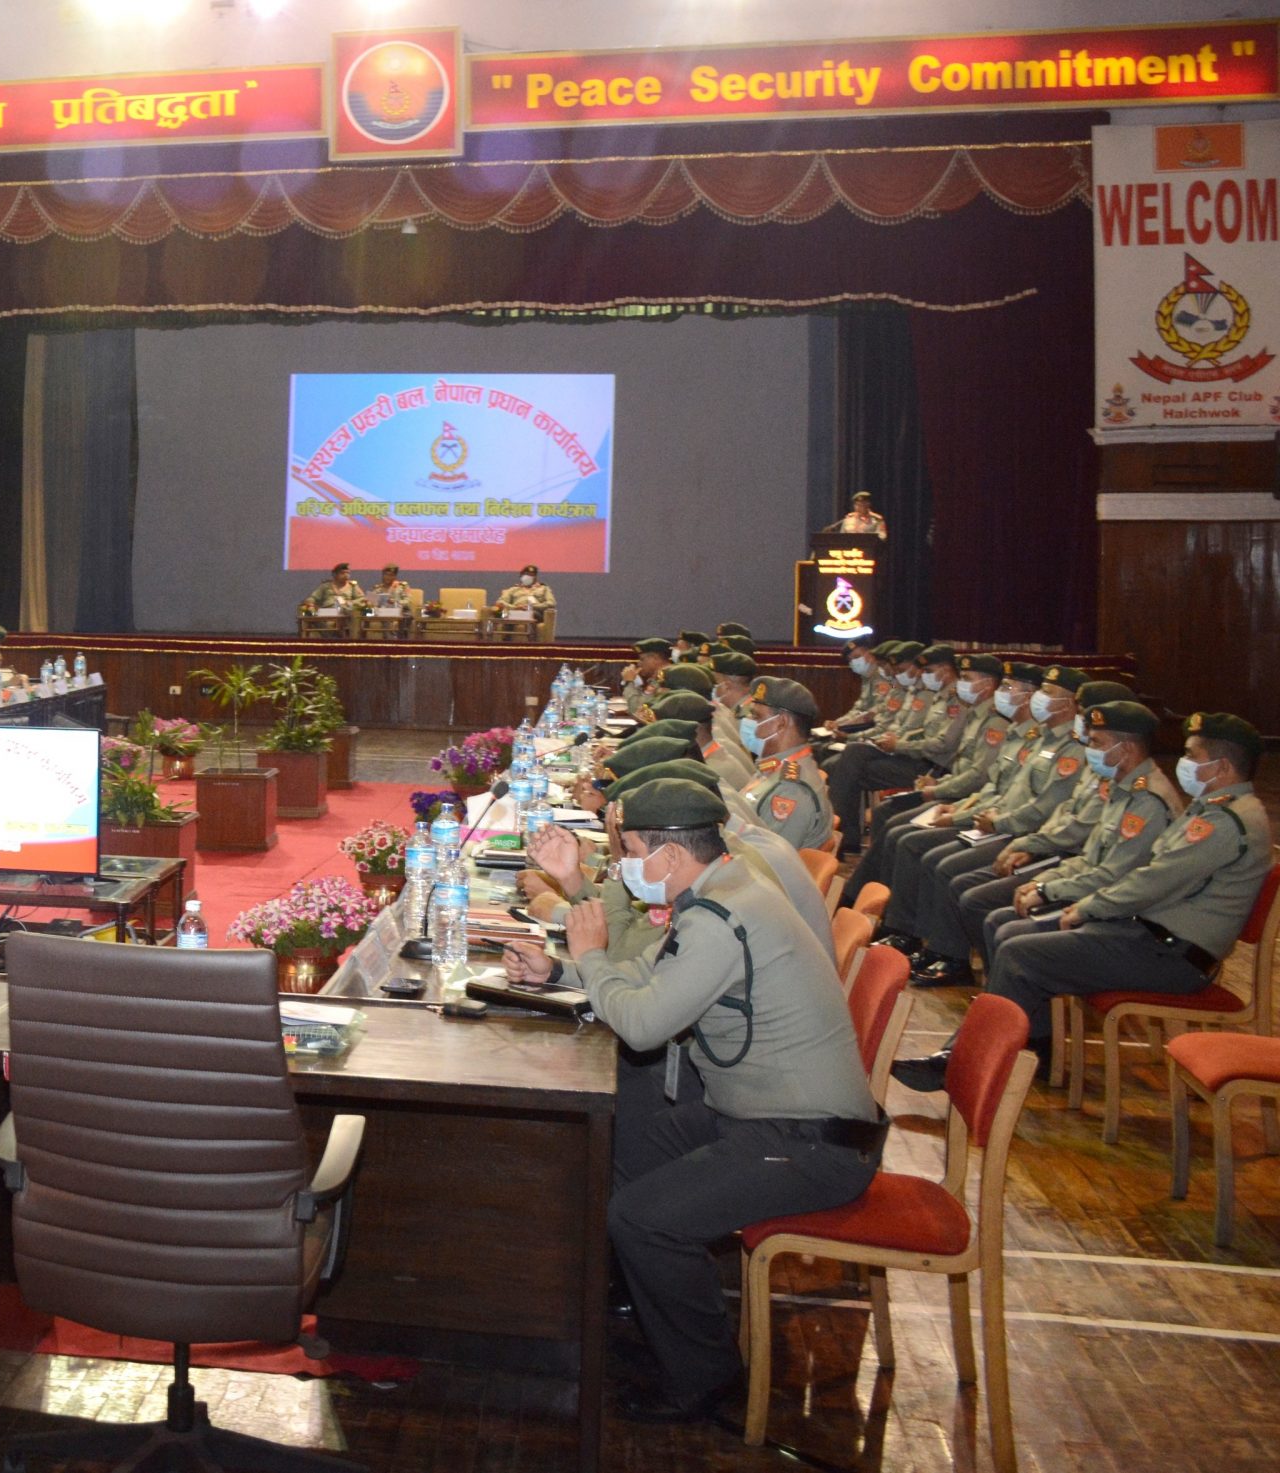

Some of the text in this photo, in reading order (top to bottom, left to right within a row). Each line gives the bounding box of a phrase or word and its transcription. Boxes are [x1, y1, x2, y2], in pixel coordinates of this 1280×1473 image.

[526, 73, 662, 109] Peace
[690, 59, 882, 105] Security
[908, 50, 1219, 93] Commitment
[1141, 391, 1264, 405] Nepal APF Club
[305, 424, 353, 480] सशस्त्र
[350, 392, 396, 434] प्रहरी
[433, 379, 484, 405] नेपाल
[487, 388, 533, 419] प्रधान
[532, 412, 600, 478] कार्यालय
